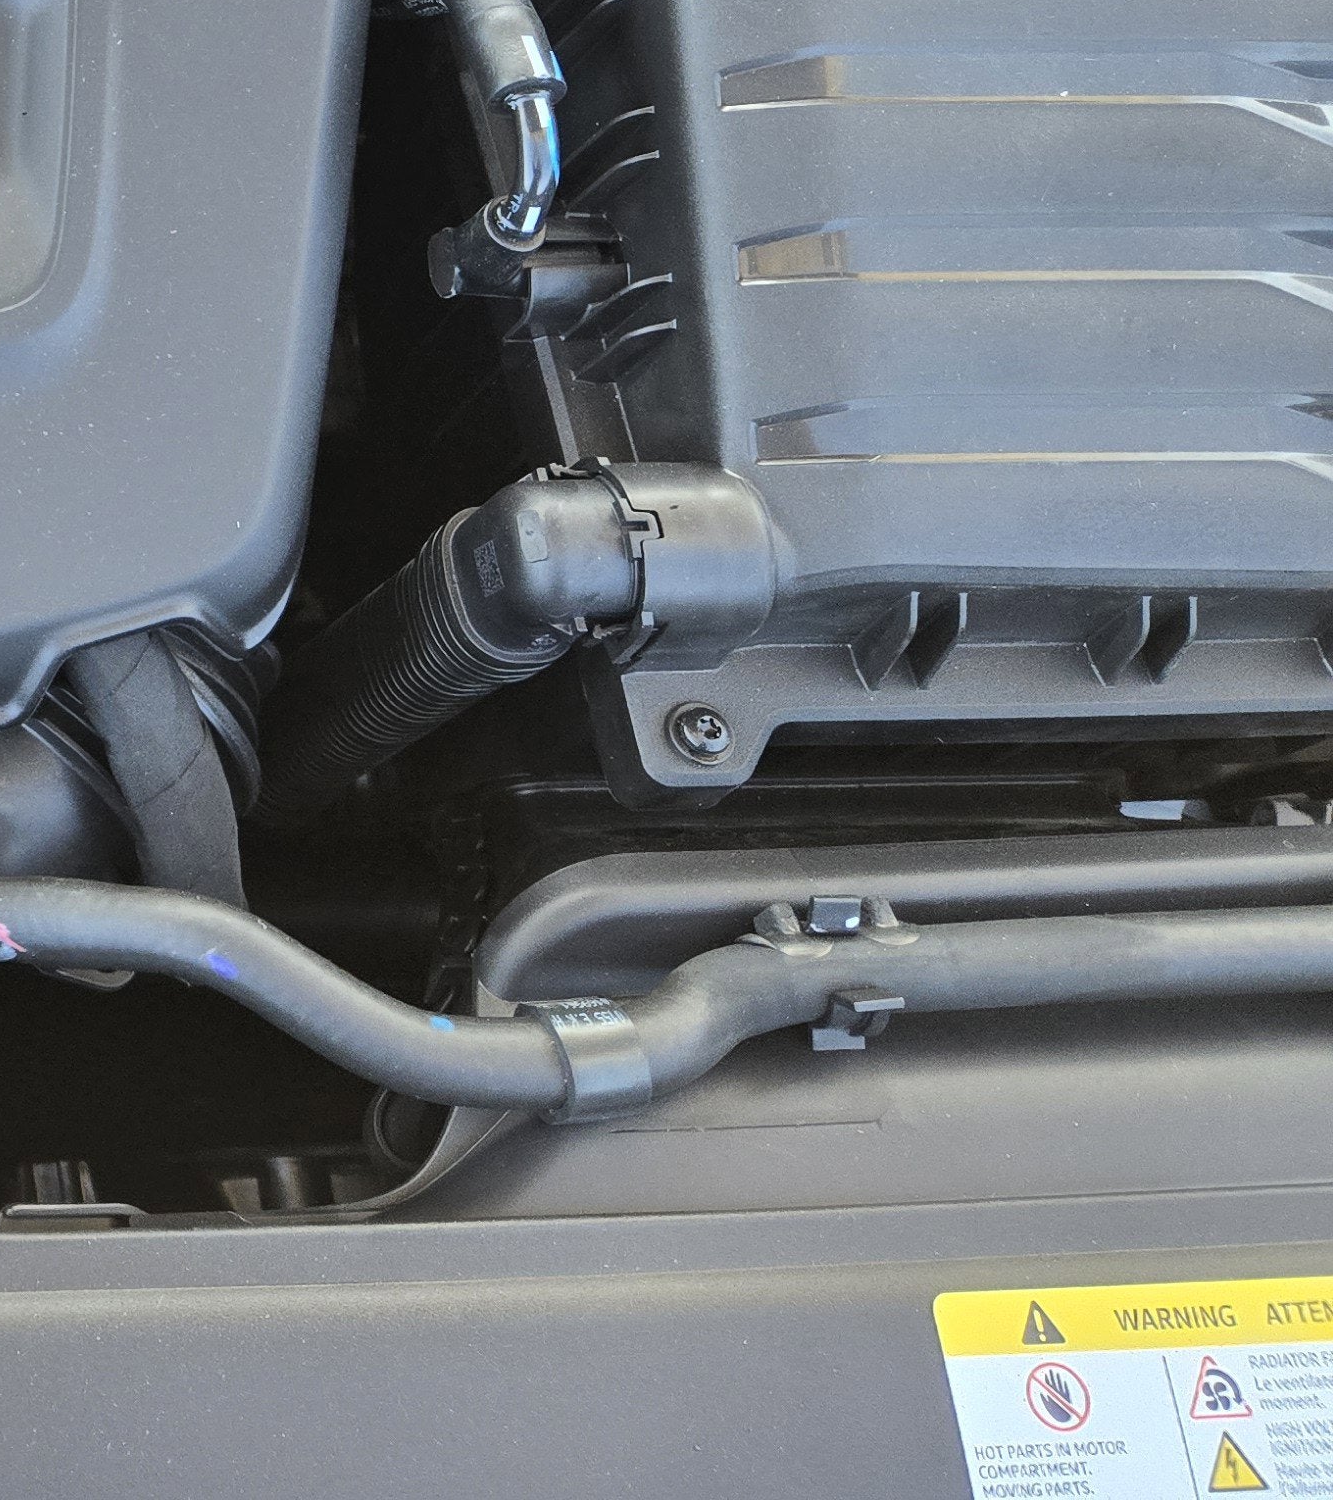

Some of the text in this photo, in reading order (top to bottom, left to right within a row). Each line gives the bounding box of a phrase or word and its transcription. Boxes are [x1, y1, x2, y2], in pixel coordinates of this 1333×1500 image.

[1114, 1304, 1238, 1332] WARNING
[974, 1440, 1129, 1462] HOT PARTS IN MOTOR
[978, 1460, 1093, 1480] COMPARTMENT.
[982, 1480, 1095, 1499] MOVING PARTS.
